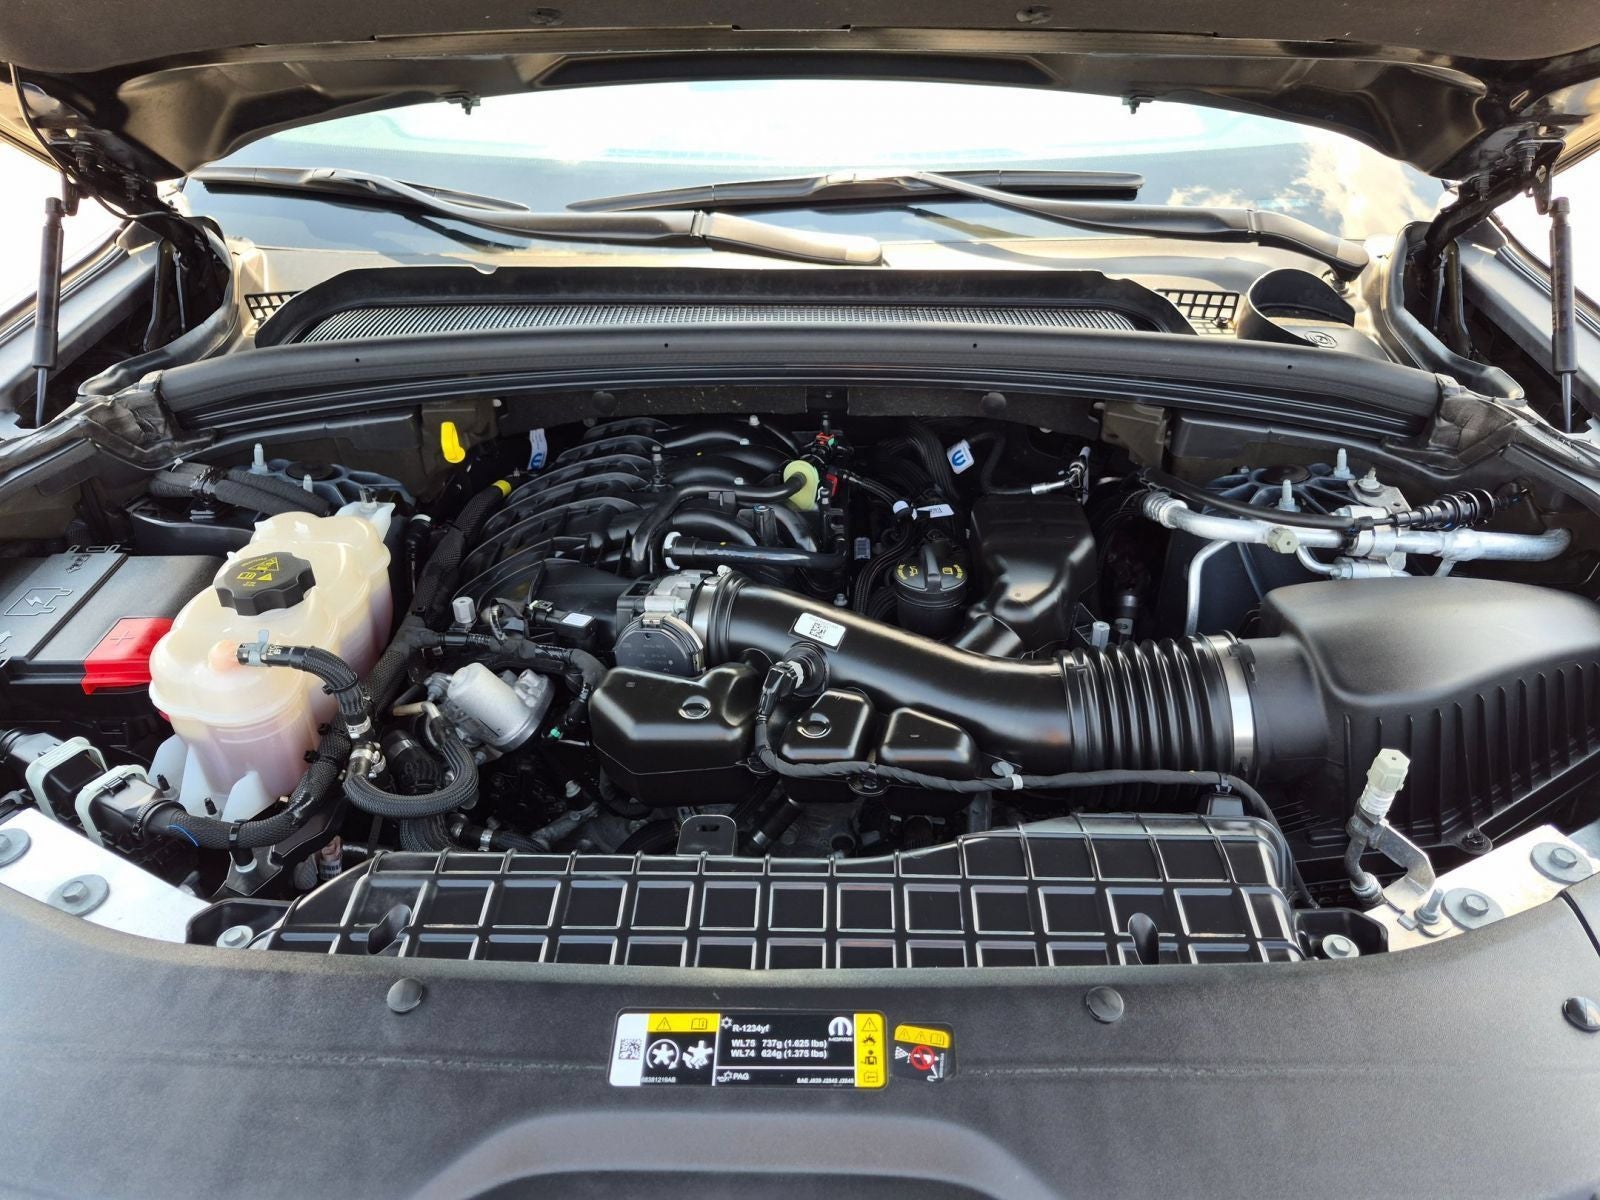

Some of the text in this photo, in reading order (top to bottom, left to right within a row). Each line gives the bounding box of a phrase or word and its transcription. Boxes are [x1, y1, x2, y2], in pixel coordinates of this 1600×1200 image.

[732, 1024, 770, 1034] R-1234yf
[731, 1039, 756, 1048] WL75
[762, 1039, 782, 1049] 737g
[811, 1039, 828, 1049] lbs)
[730, 1049, 828, 1059] WL74 624g (1.375 lbs)
[732, 1072, 750, 1080] PAG
